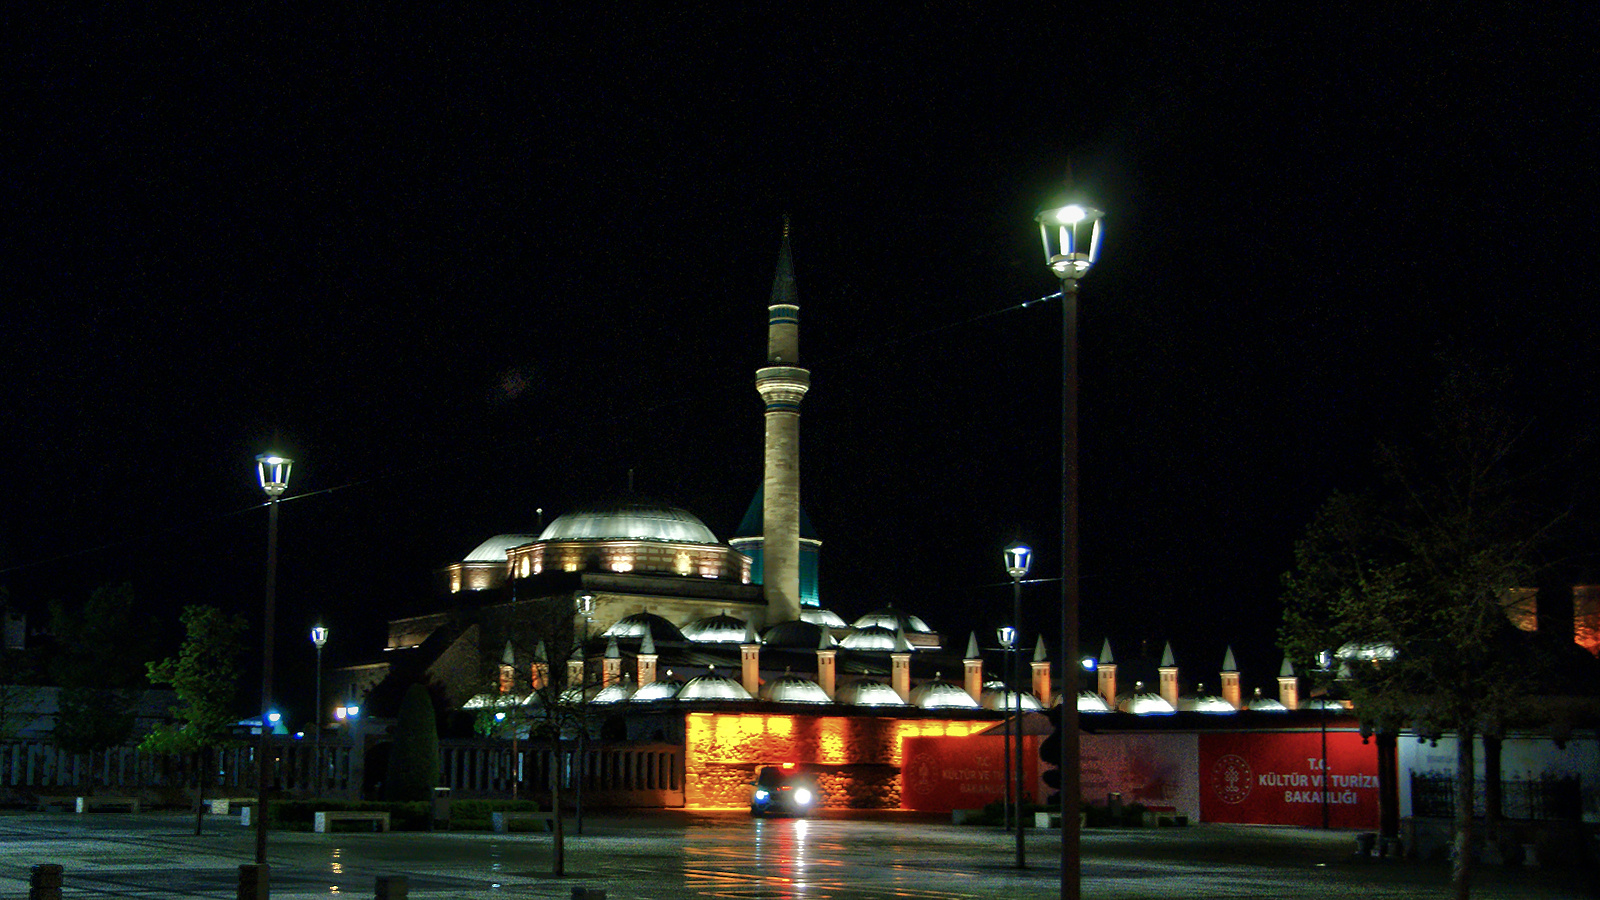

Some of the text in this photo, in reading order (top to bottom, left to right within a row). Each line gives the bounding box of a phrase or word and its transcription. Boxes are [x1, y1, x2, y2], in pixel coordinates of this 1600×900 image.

[977, 770, 990, 781] VE
[1258, 771, 1308, 787] KÜLTÜR
[1285, 789, 1357, 804] BAKANLIĞI
